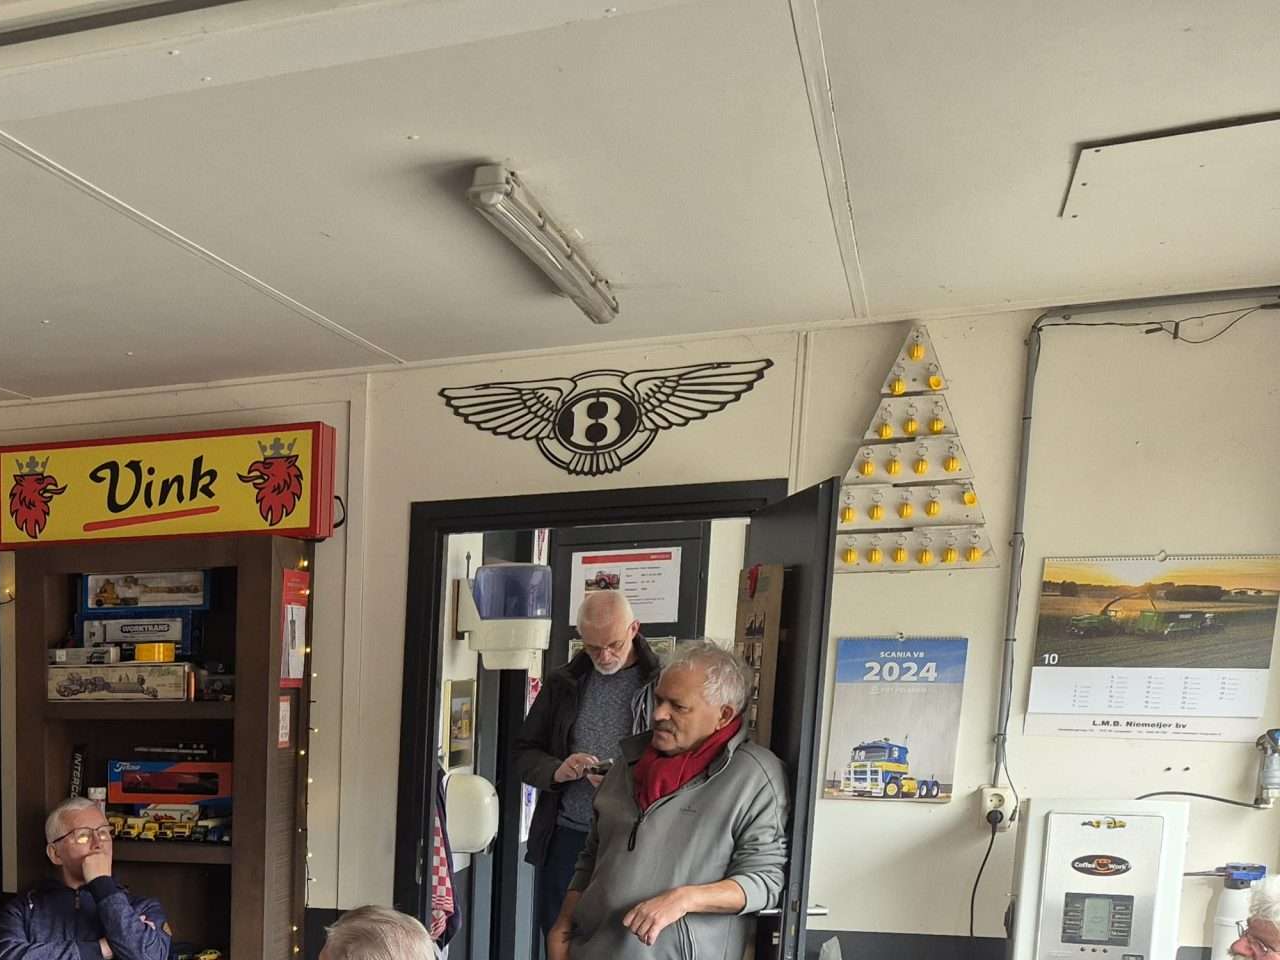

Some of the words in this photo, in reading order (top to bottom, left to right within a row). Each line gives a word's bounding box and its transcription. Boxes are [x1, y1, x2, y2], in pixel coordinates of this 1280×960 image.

[89, 455, 218, 513] Vink
[121, 624, 169, 633] WORKTRANS
[1042, 653, 1059, 665] 10
[863, 661, 938, 682] 2024
[1125, 721, 1172, 729] Niemeijer
